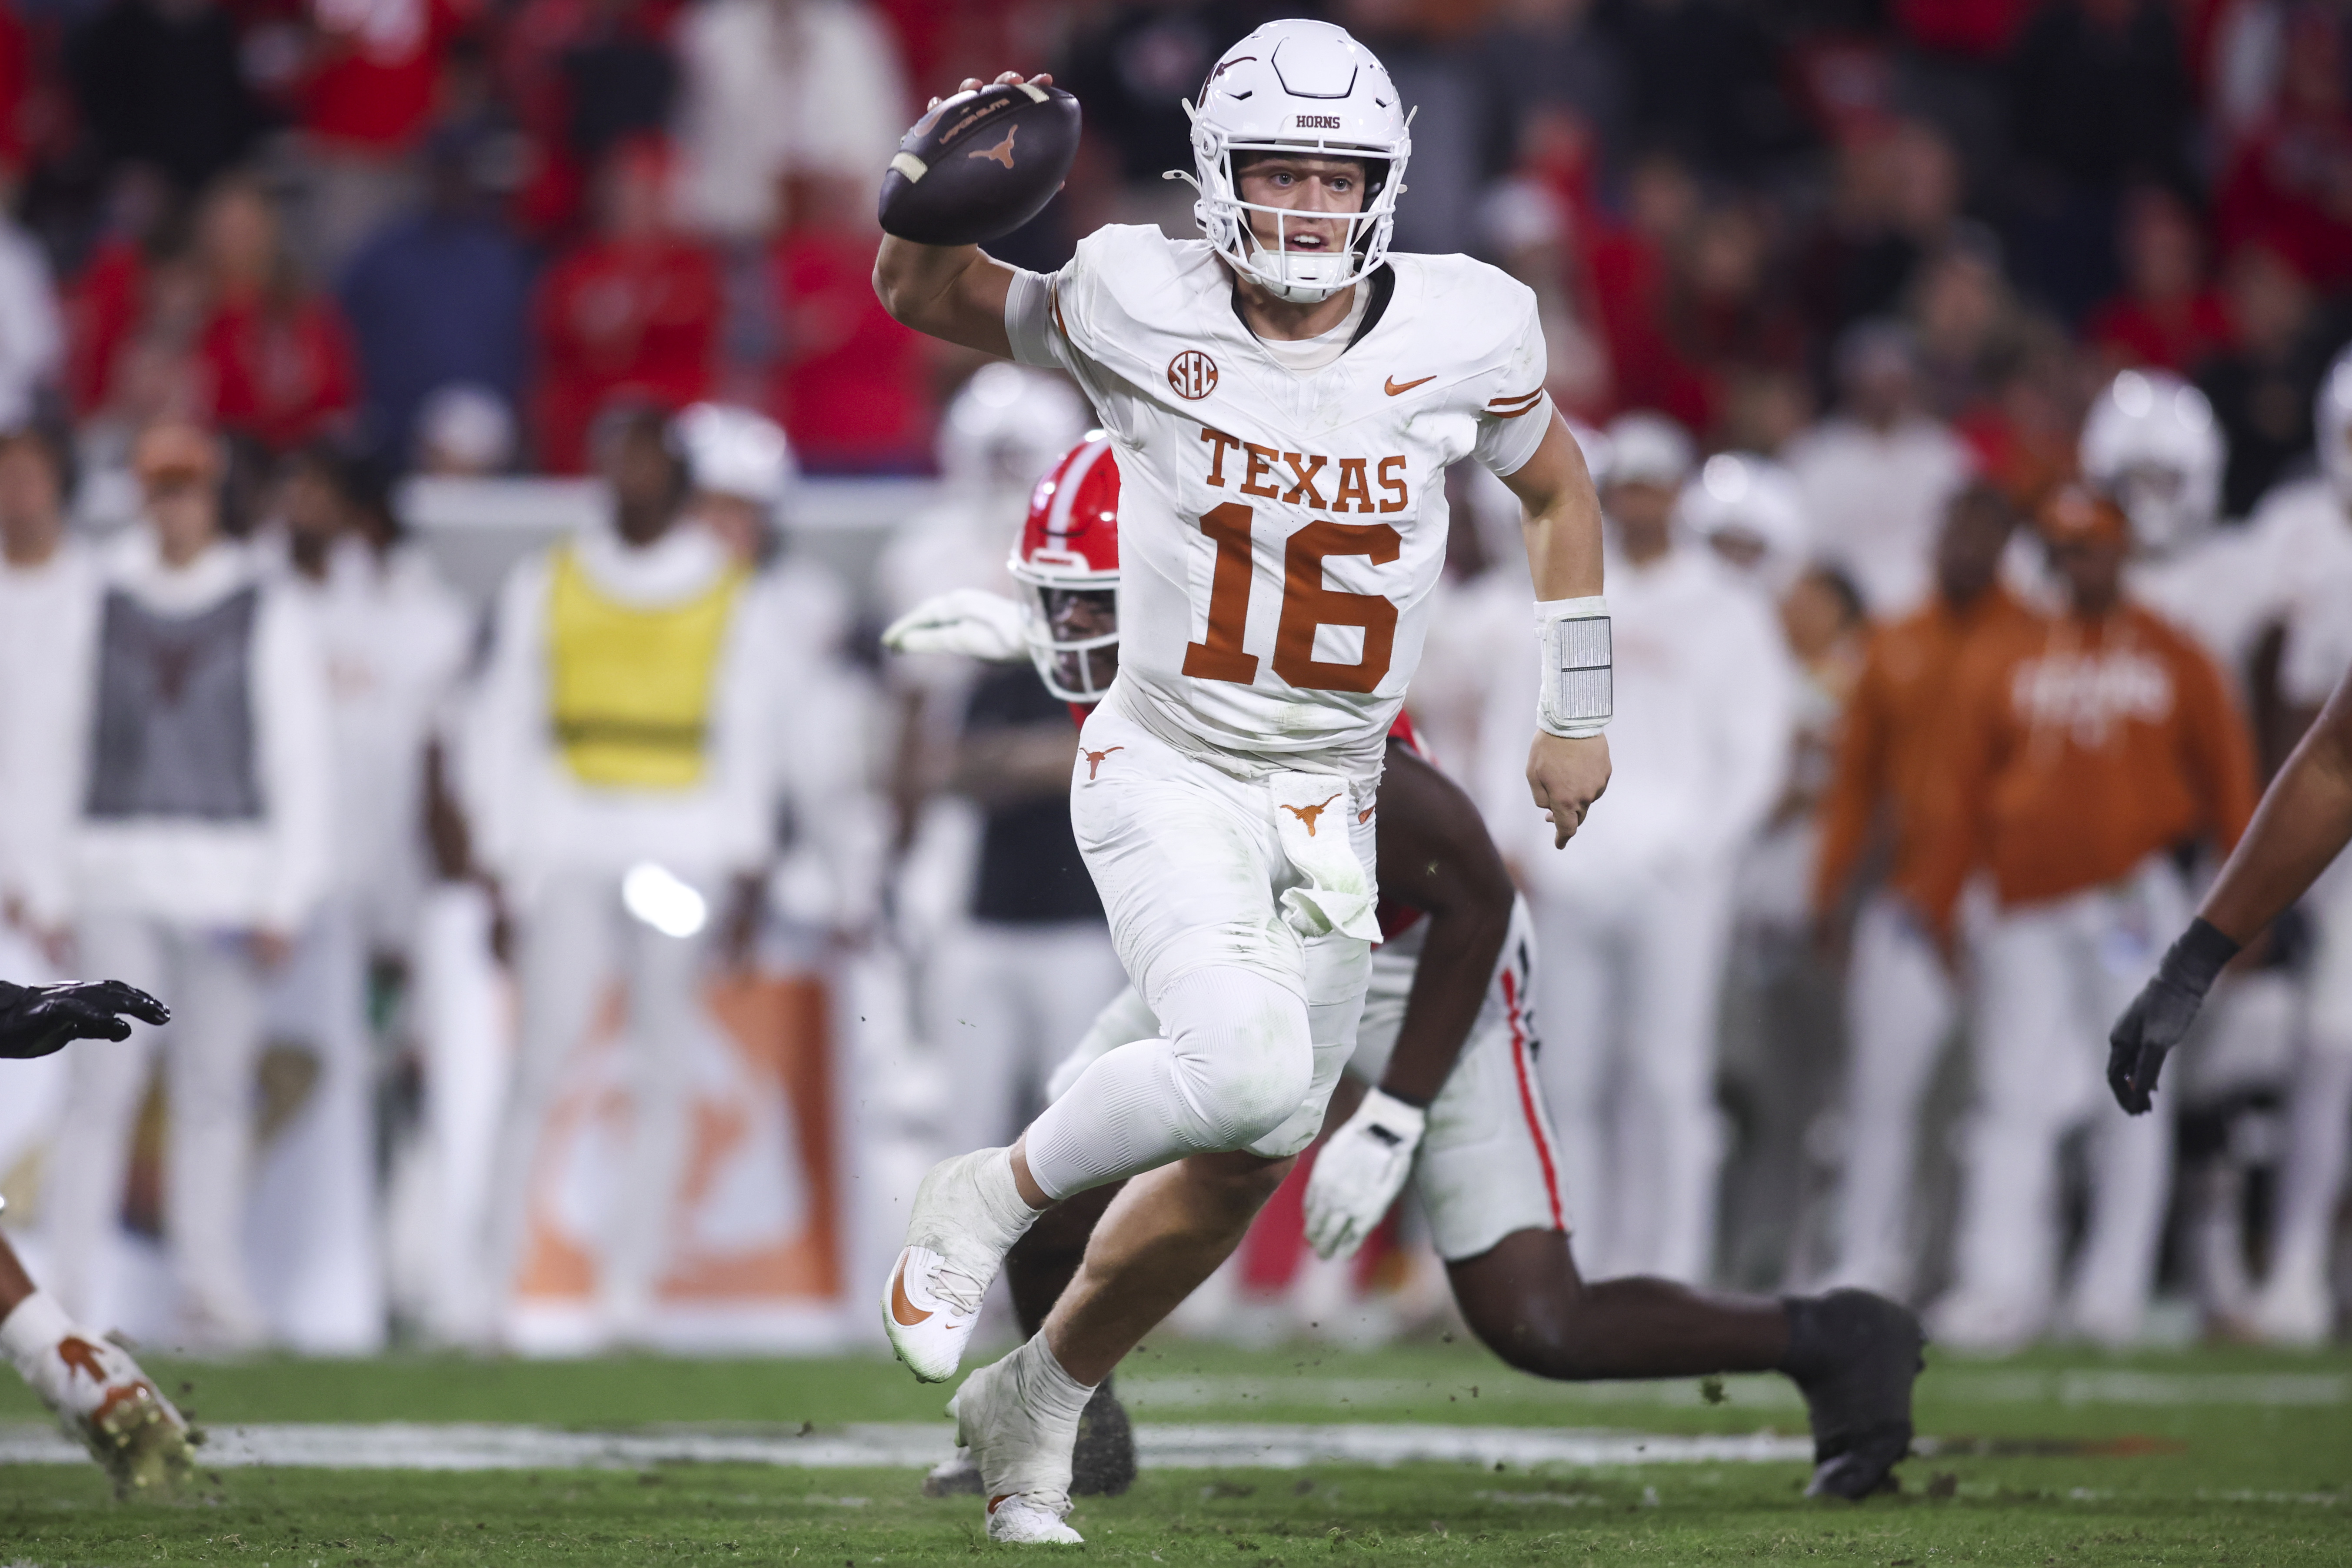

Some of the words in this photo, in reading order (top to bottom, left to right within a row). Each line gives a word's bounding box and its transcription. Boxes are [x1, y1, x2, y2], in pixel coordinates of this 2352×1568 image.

[1296, 115, 1340, 129] HORNS
[1170, 352, 1215, 398] SEC
[1200, 427, 1408, 513] TEXAS
[1181, 501, 1403, 693] 16
